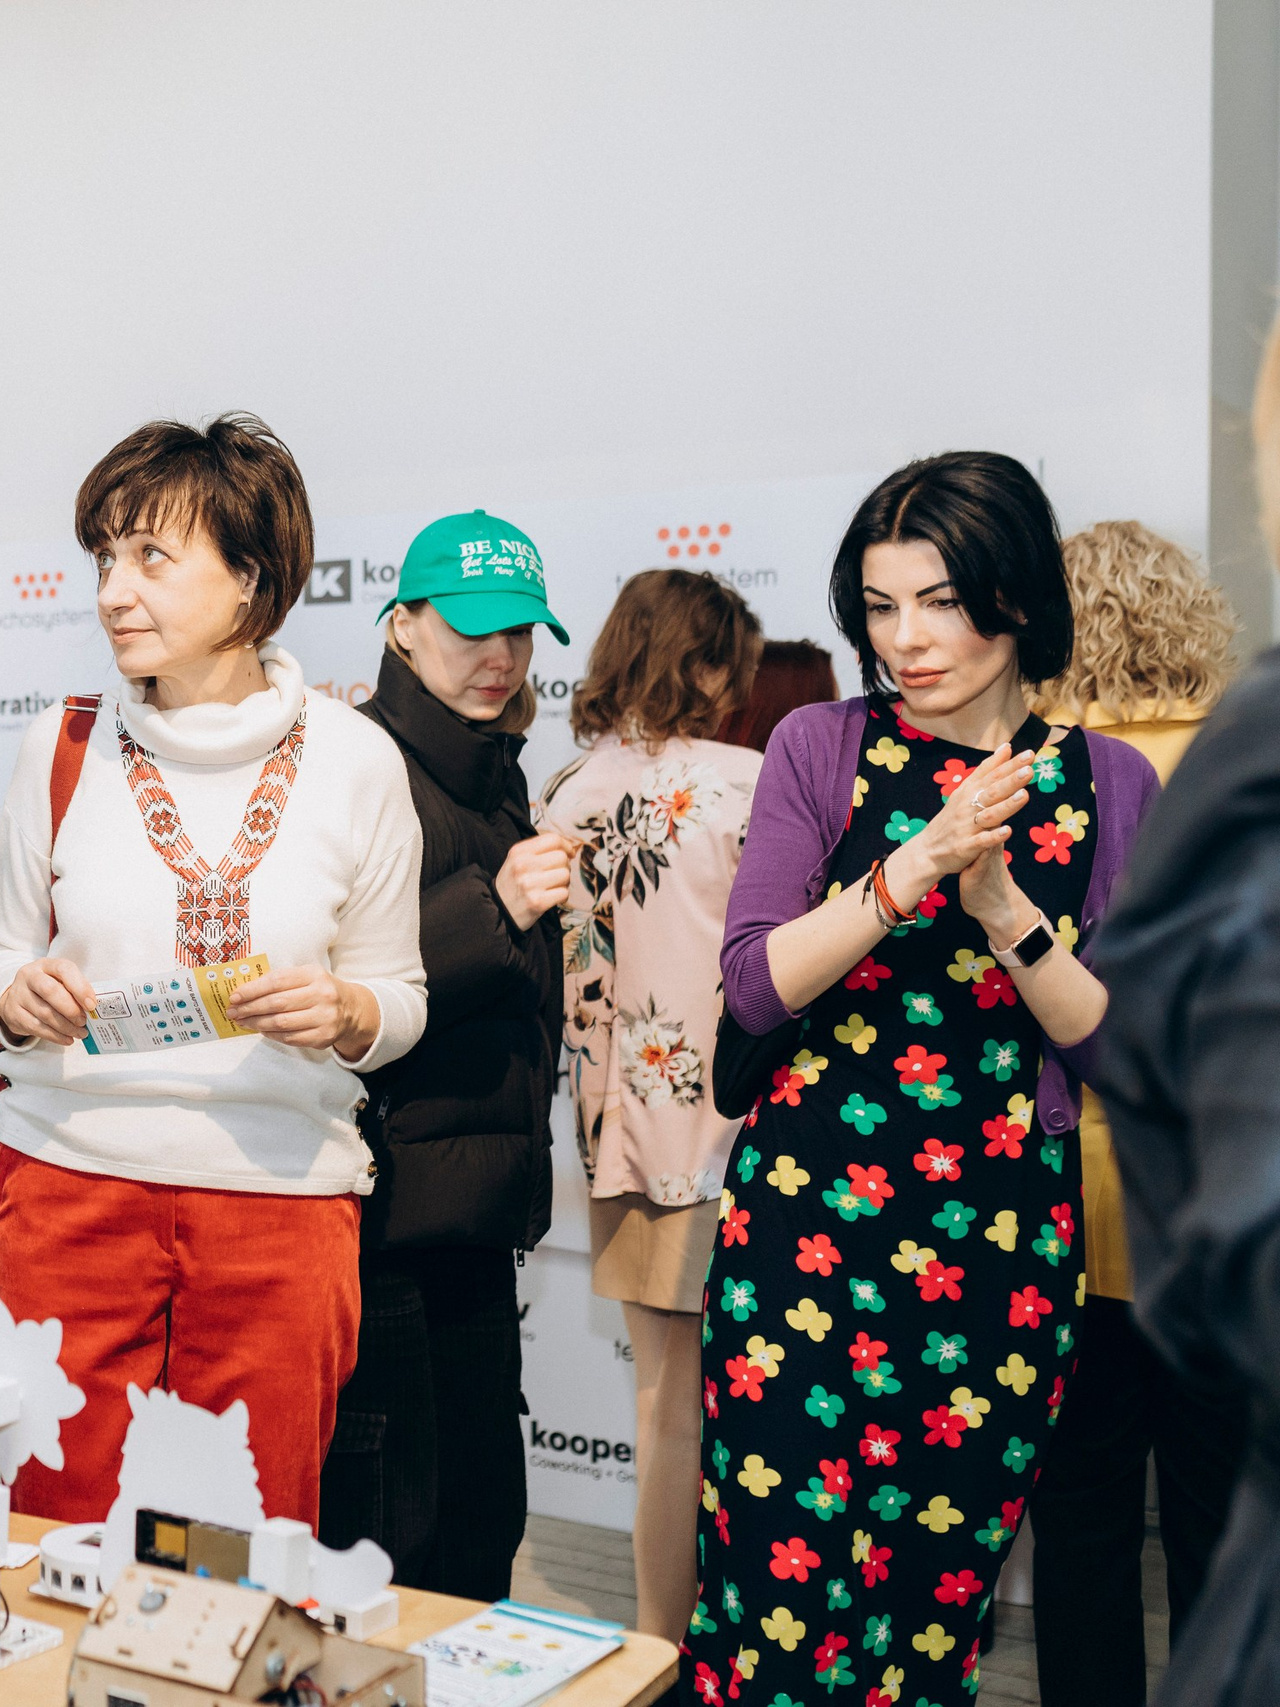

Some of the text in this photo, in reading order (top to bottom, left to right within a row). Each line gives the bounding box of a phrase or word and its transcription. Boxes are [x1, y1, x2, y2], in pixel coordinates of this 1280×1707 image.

[459, 540, 493, 558] BE
[461, 556, 483, 571] Get
[485, 553, 513, 566] Lots
[514, 556, 527, 571] Of
[530, 1420, 637, 1464] koope
